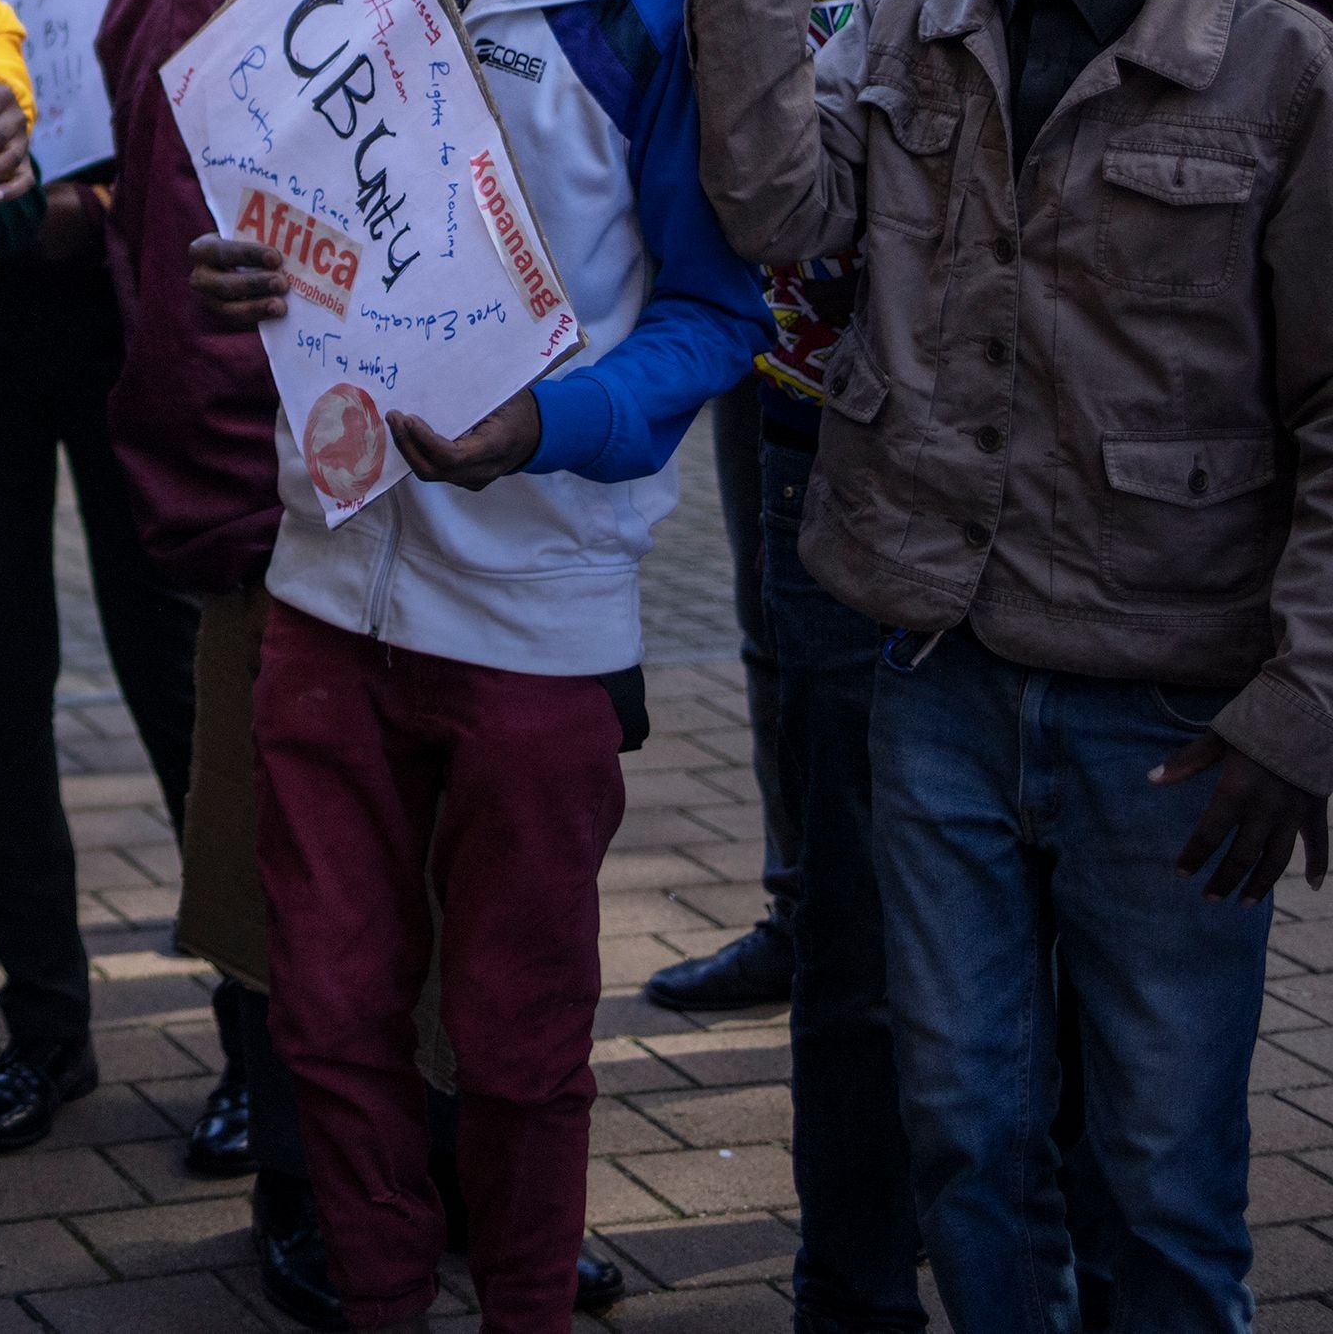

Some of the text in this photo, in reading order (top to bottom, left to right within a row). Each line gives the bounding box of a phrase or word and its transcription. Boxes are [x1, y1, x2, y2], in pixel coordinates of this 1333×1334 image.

[491, 45, 543, 76] CORE
[439, 142, 456, 166] to
[236, 189, 359, 292] Africa
[469, 149, 560, 319] Kopanang
